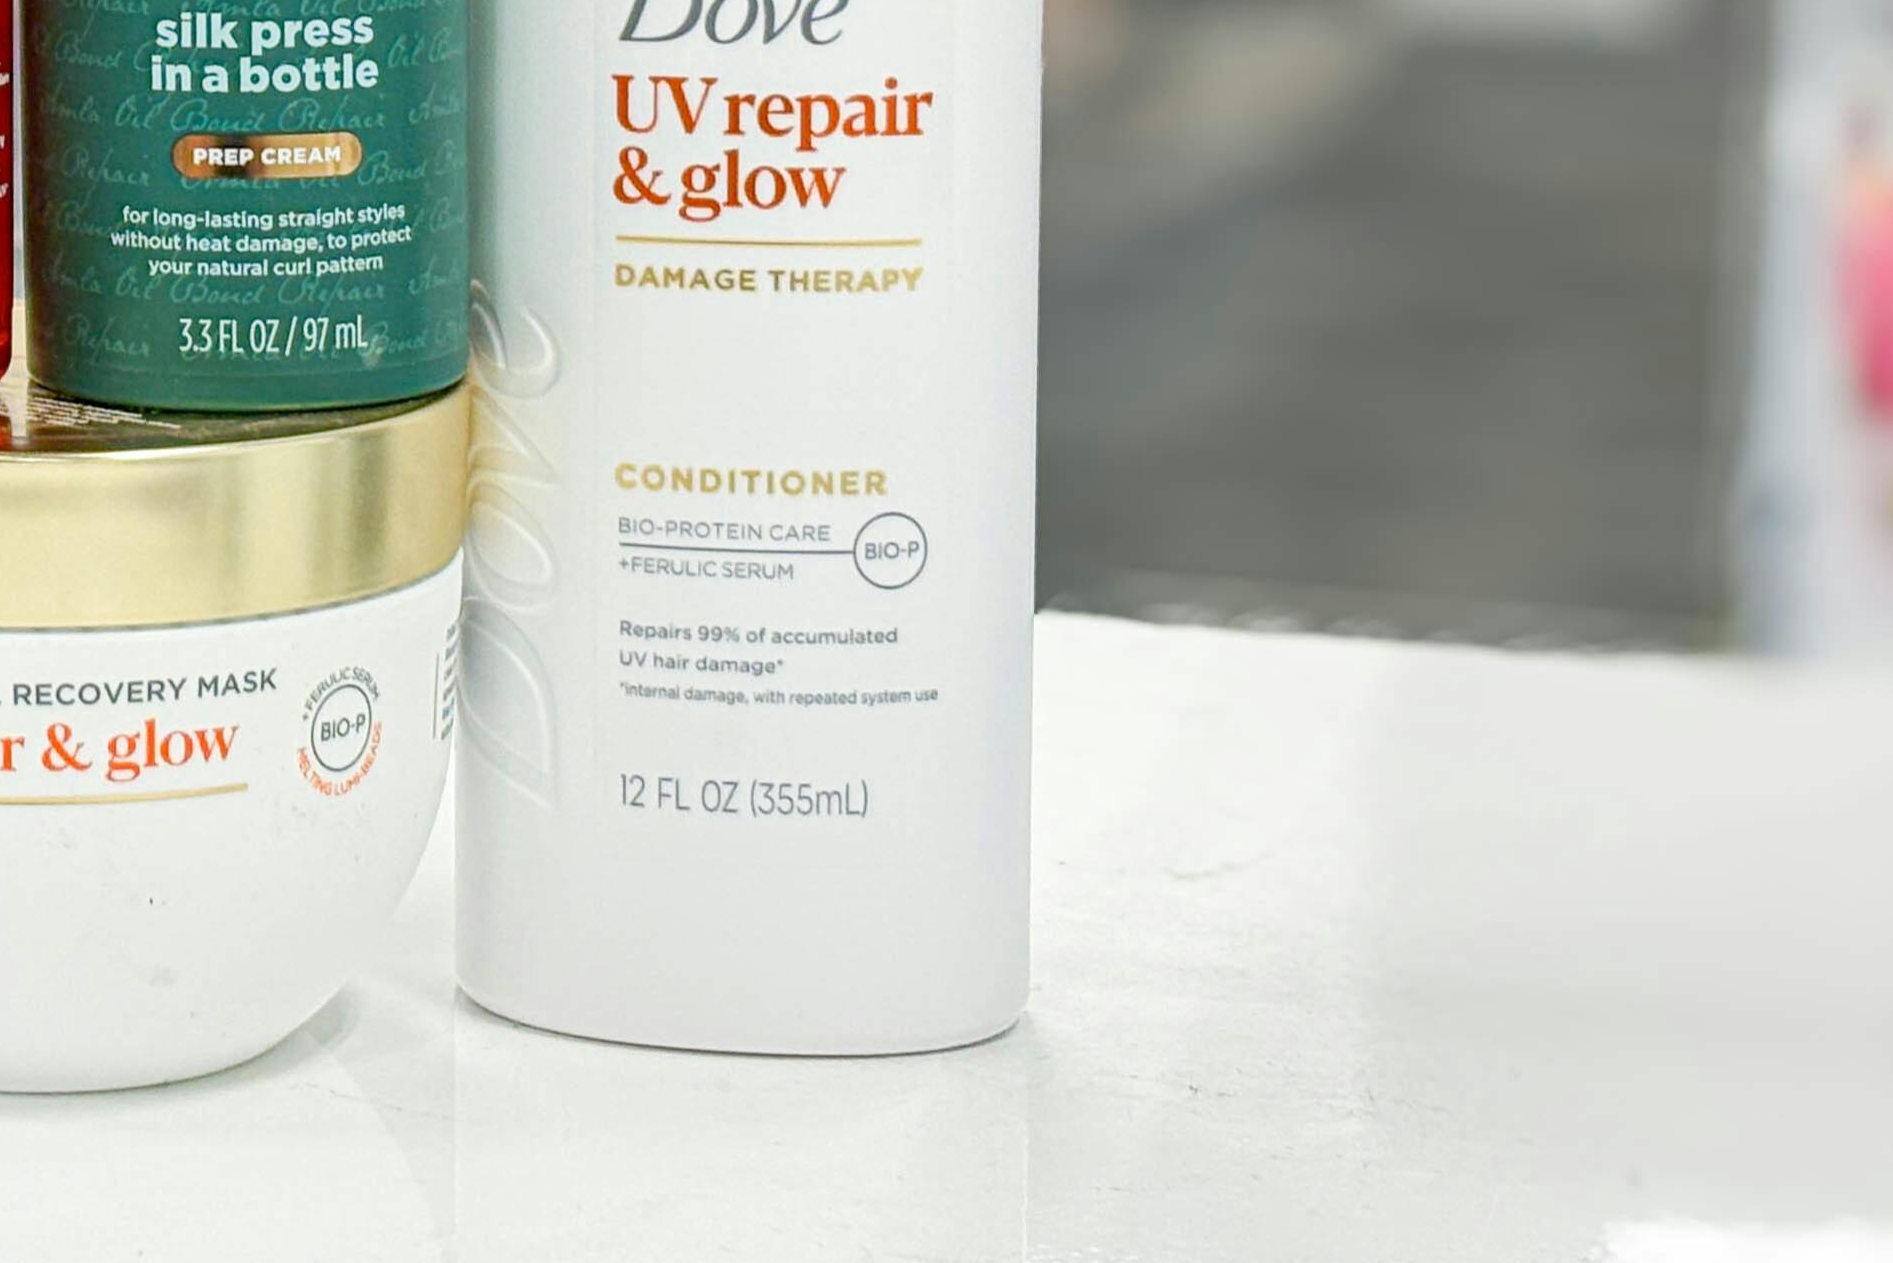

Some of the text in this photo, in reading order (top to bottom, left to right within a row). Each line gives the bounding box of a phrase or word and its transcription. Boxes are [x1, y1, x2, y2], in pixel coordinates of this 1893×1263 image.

[156, 11, 375, 56] silk press
[151, 53, 379, 94] in a bottle
[611, 73, 934, 154] UV repair
[193, 145, 341, 167] PREP CREAM
[613, 145, 847, 224] & glow
[122, 202, 406, 231] for long-lasting straight styles
[111, 225, 412, 255] without heat damage, to protect
[148, 254, 384, 277] your natural curl pattern
[614, 263, 924, 294] DAMAGE THERAPY
[178, 314, 369, 357] 3.3 FL OZ / 97 mL
[614, 462, 889, 497] CONDITIONER
[617, 516, 832, 543] BIO-PROTEIN CARE
[863, 540, 921, 561] BIO-P
[721, 562, 795, 581] SERUM
[619, 619, 899, 645] Repairs 99% of accumulated
[619, 650, 648, 668] UV
[652, 651, 690, 670] hair
[12, 676, 188, 706] RECOVERY
[197, 667, 278, 698] MASK
[683, 685, 750, 706] damage,
[754, 688, 786, 704] with
[789, 688, 857, 707] repeated
[860, 689, 912, 708] system
[915, 687, 939, 702] use
[320, 713, 367, 742] BIO-P
[41, 721, 93, 772] &
[104, 717, 240, 784] glow
[620, 772, 869, 819] 12 FL OZ (355mL)
